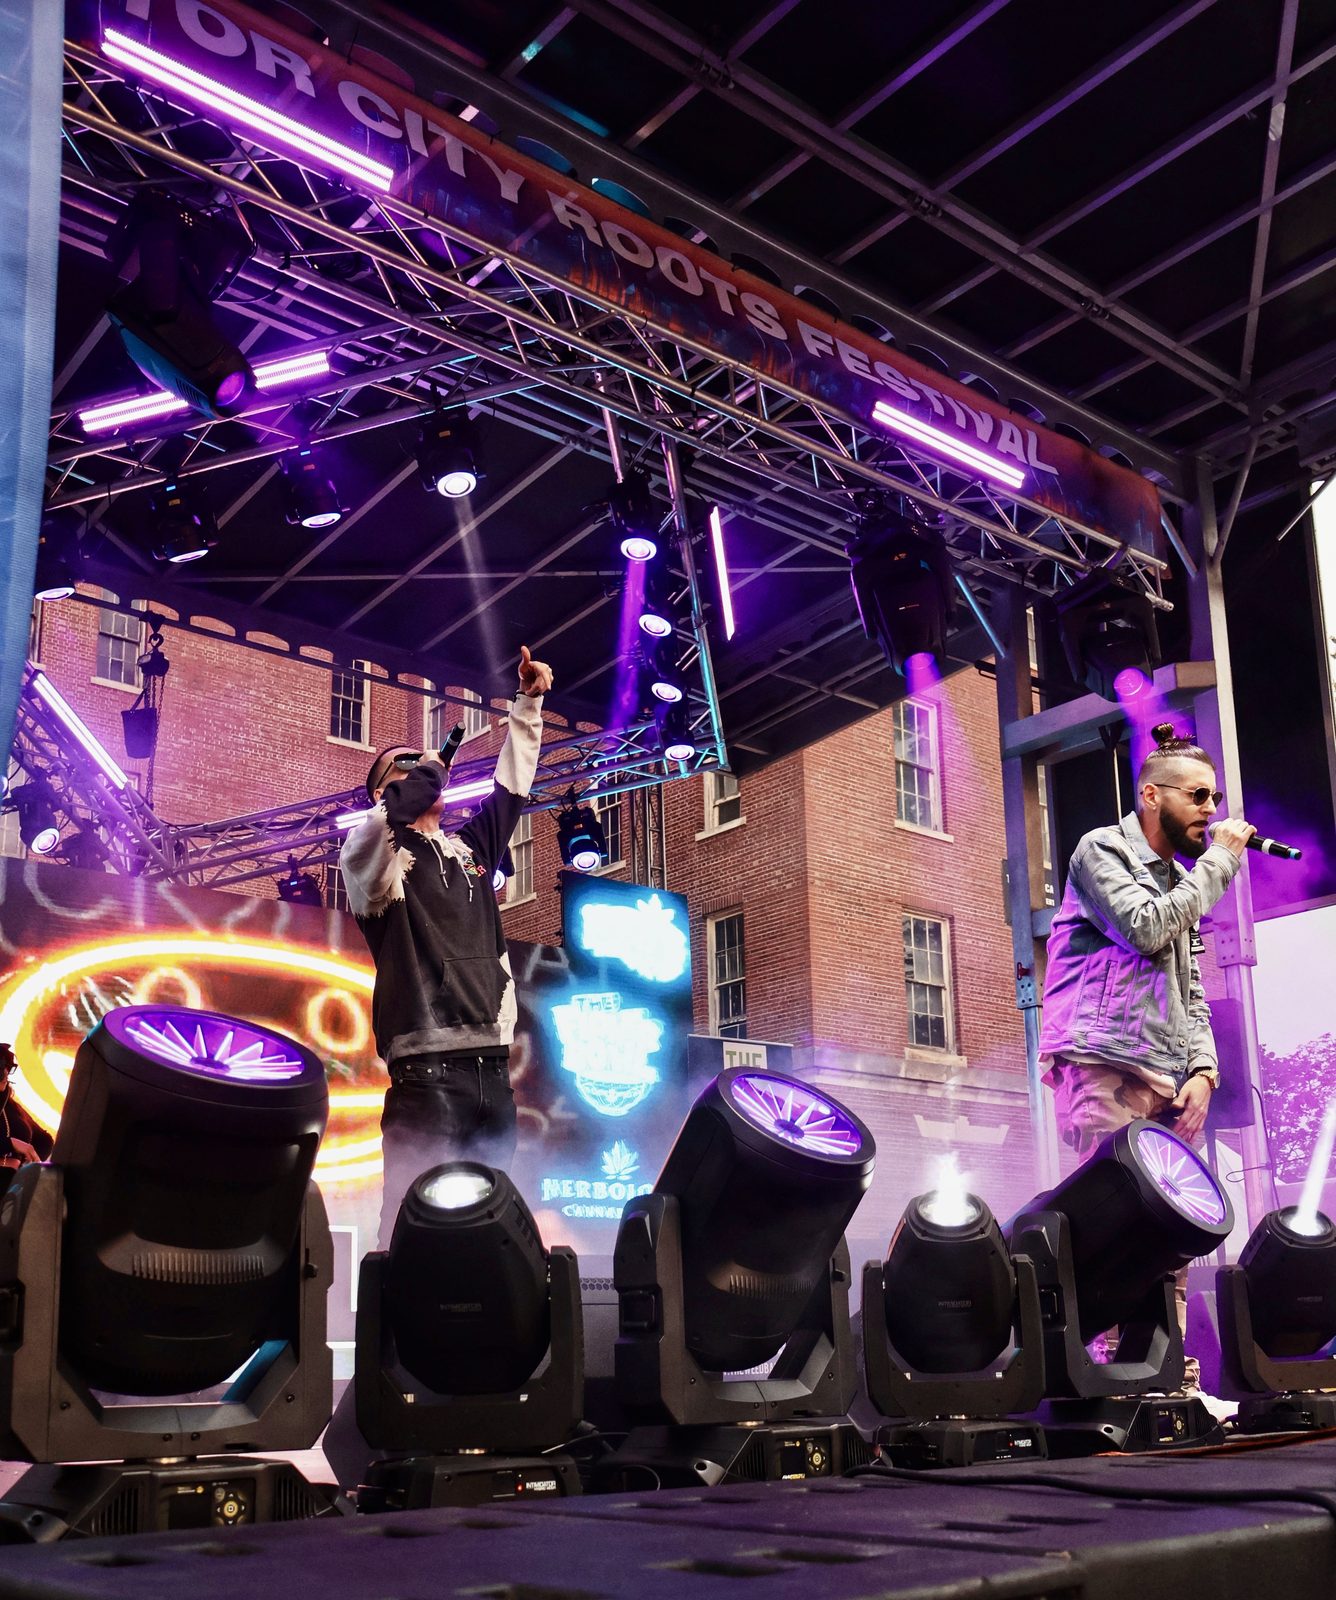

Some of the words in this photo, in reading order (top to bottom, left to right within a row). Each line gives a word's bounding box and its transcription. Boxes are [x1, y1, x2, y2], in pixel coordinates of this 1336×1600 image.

[338, 80, 525, 204] CITY
[547, 189, 788, 340] ROOTS
[796, 319, 1059, 476] FESTIVAL
